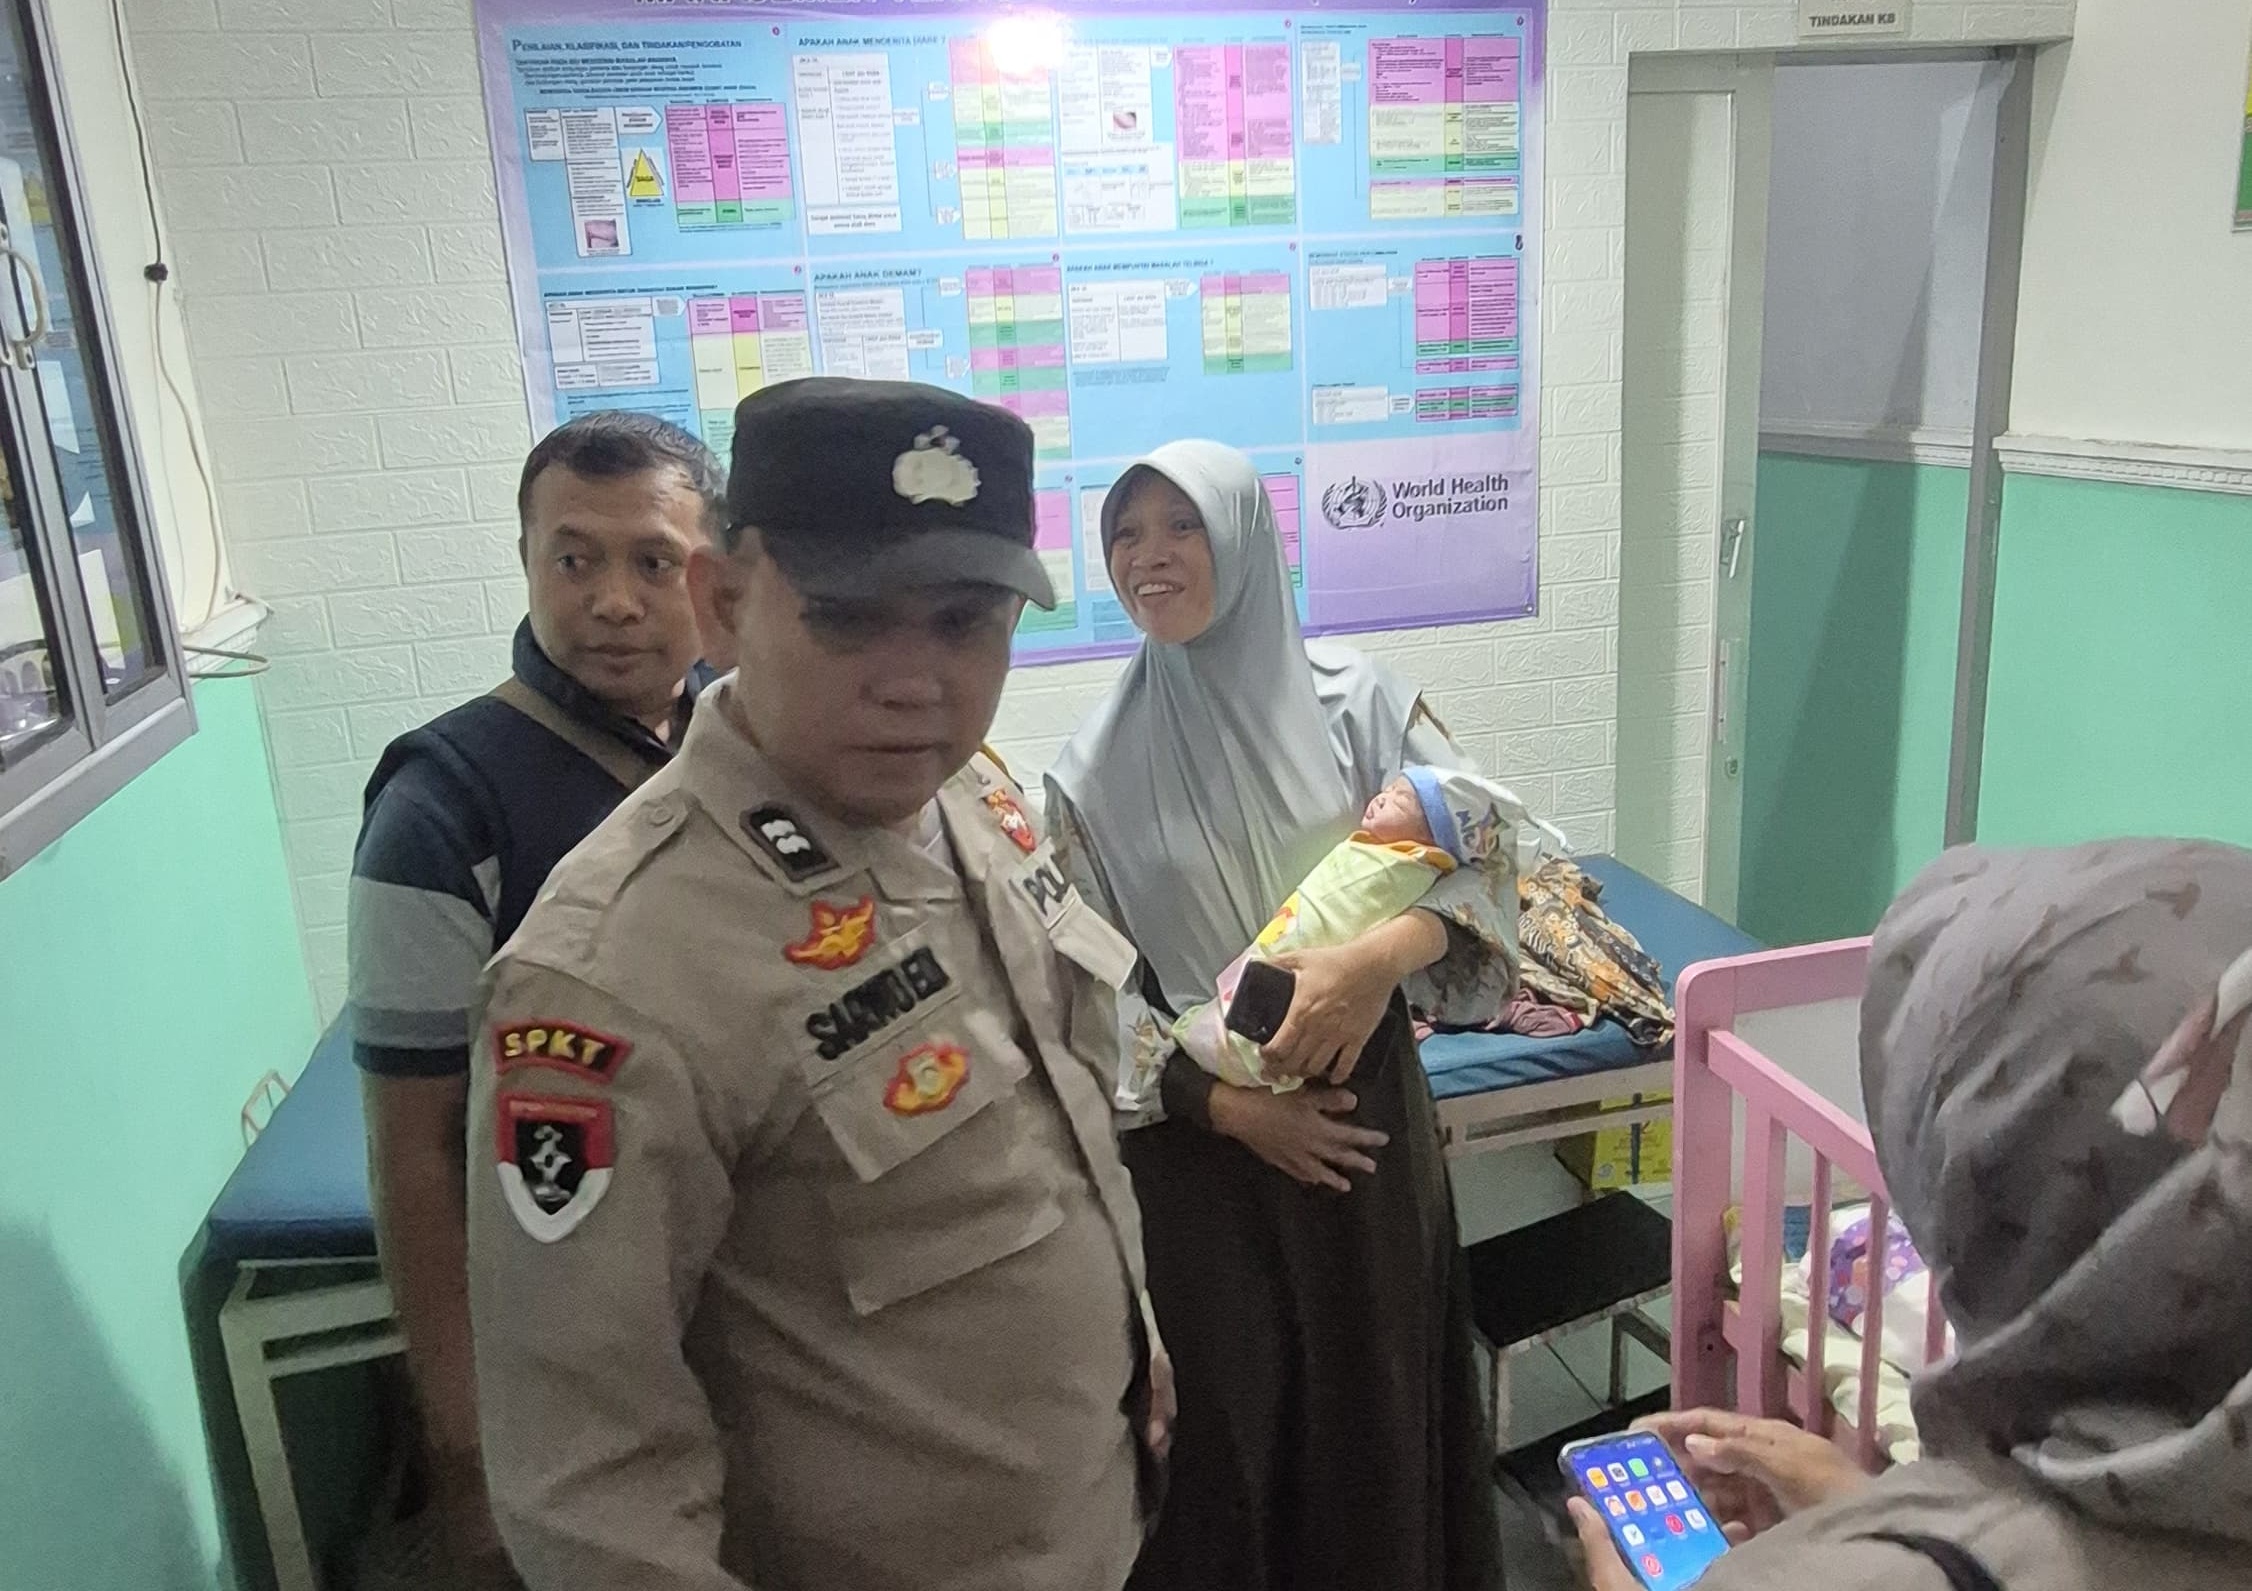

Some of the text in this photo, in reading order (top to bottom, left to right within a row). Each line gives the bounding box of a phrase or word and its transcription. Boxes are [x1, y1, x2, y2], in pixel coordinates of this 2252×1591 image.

[1807, 12, 1896, 28] TINDAKAN KB
[1392, 473, 1509, 499] World Health
[1392, 495, 1508, 522] Organization
[504, 1028, 606, 1065] SPKT
